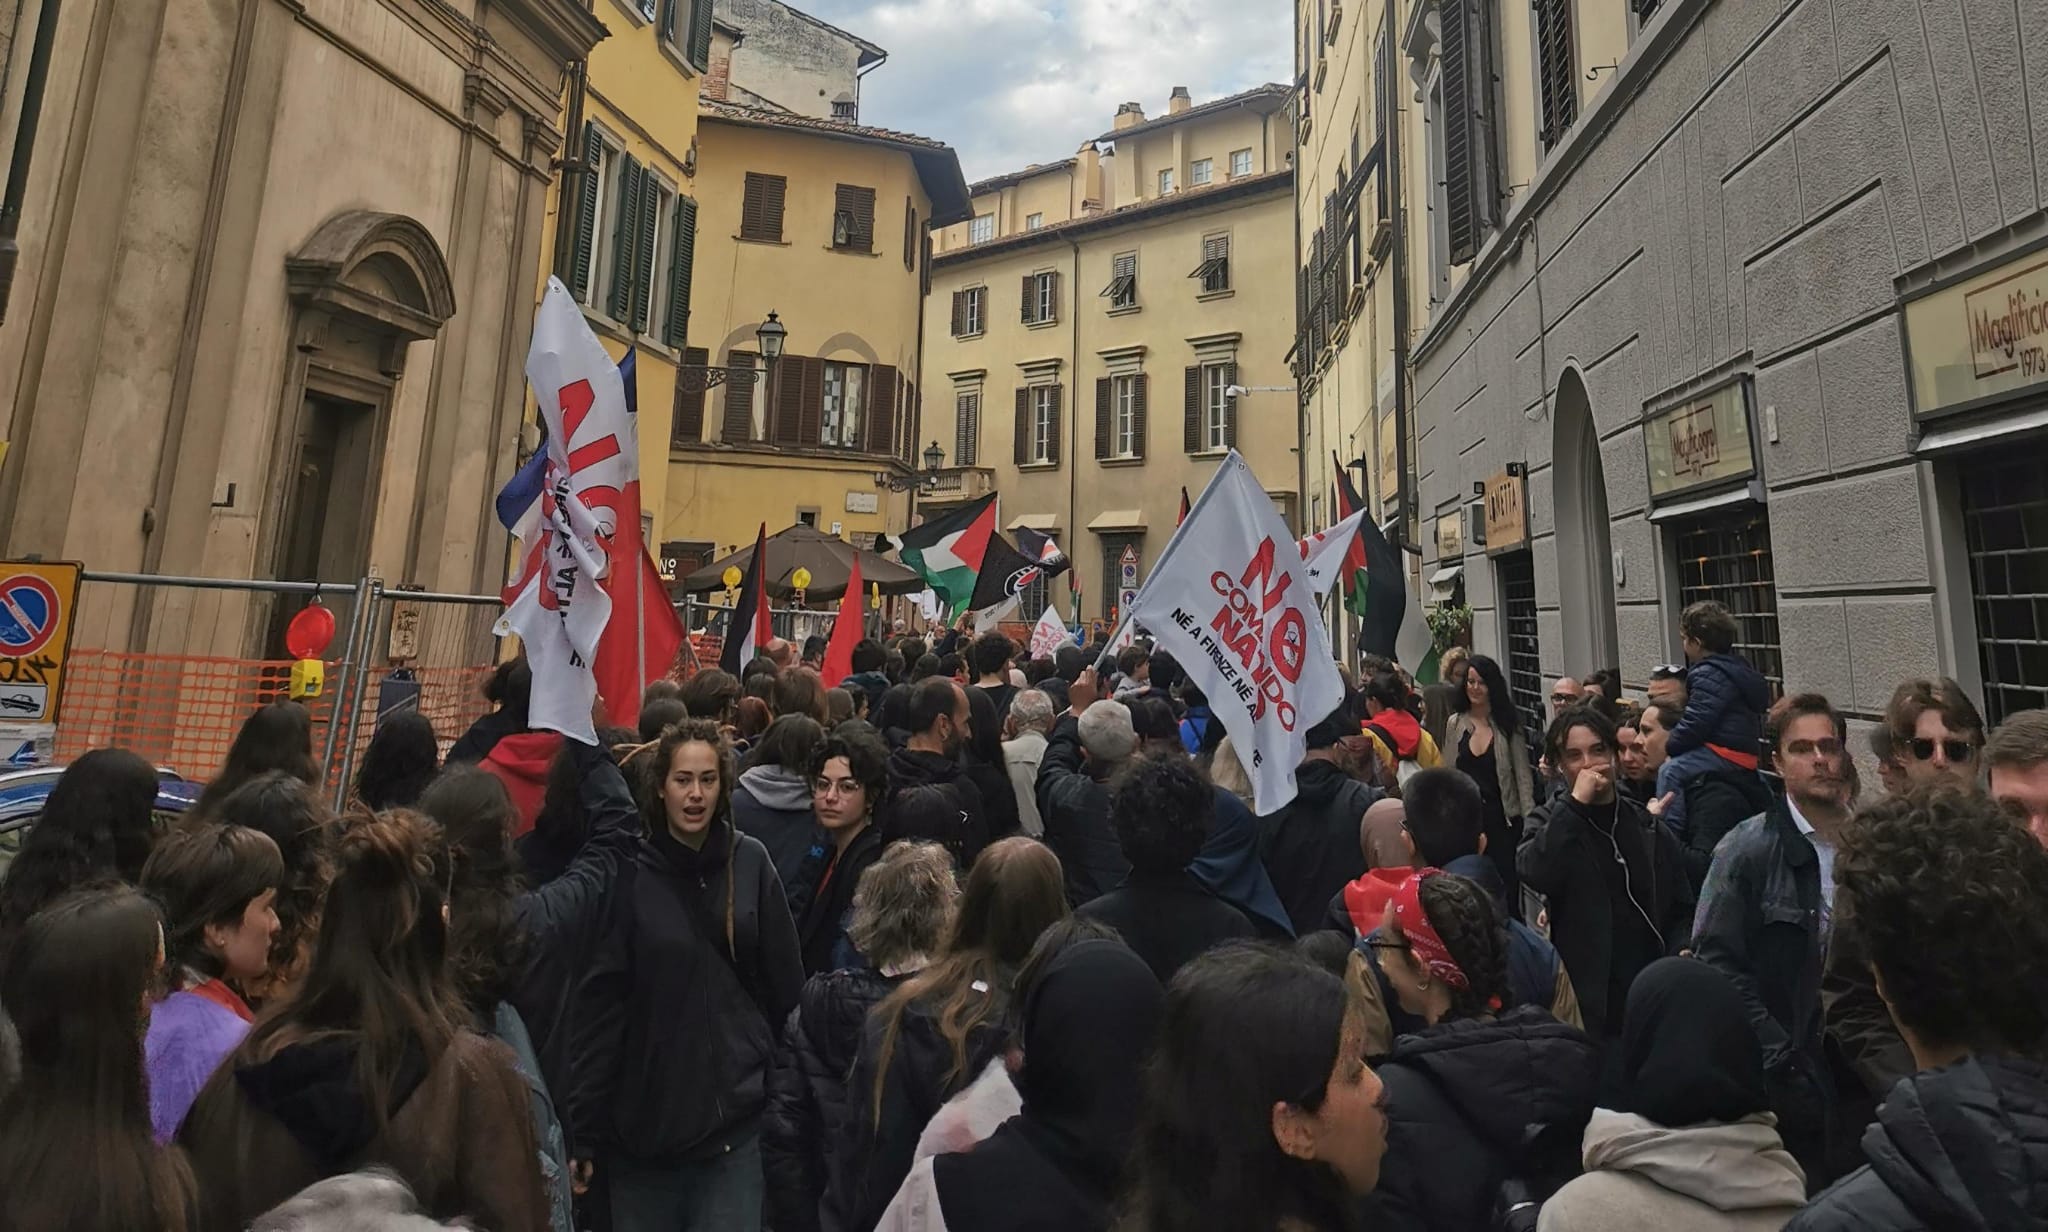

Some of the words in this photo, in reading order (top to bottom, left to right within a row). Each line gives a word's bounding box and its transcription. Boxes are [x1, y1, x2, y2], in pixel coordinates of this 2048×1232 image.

[2020, 346, 2046, 376] 1973
[1171, 607, 1195, 630] NÉ
[1188, 626, 1202, 640] A
[1231, 678, 1254, 702] NÉ
